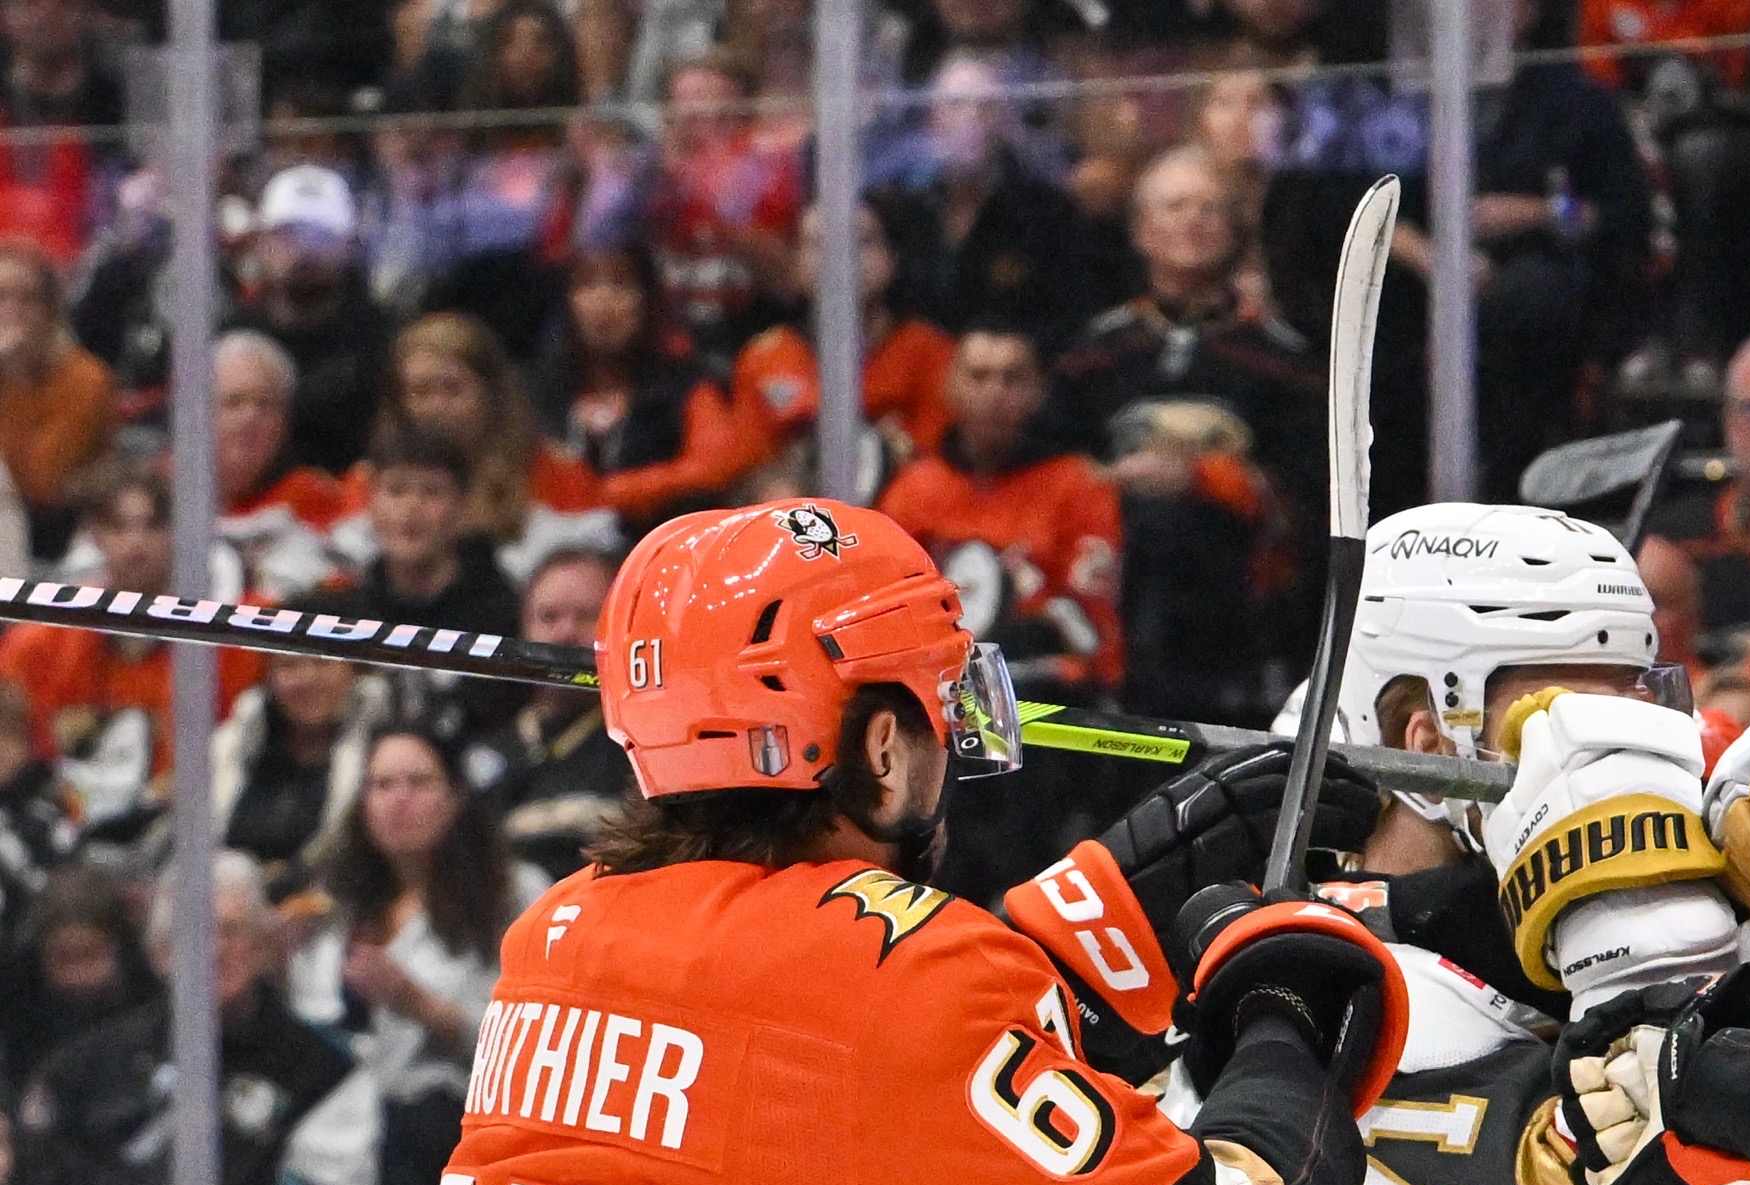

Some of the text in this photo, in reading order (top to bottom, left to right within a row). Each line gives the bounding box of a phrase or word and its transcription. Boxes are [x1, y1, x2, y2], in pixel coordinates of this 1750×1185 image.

[1415, 535, 1499, 559] NAQVI
[0, 576, 502, 659] WARRIO
[629, 638, 664, 689] 61
[1092, 738, 1161, 766] KARLSSON
[1514, 803, 1550, 855] COVERT
[1500, 811, 1690, 927] WARRI
[1562, 945, 1631, 978] KARLSSON
[464, 1000, 704, 1149] AUTHIER
